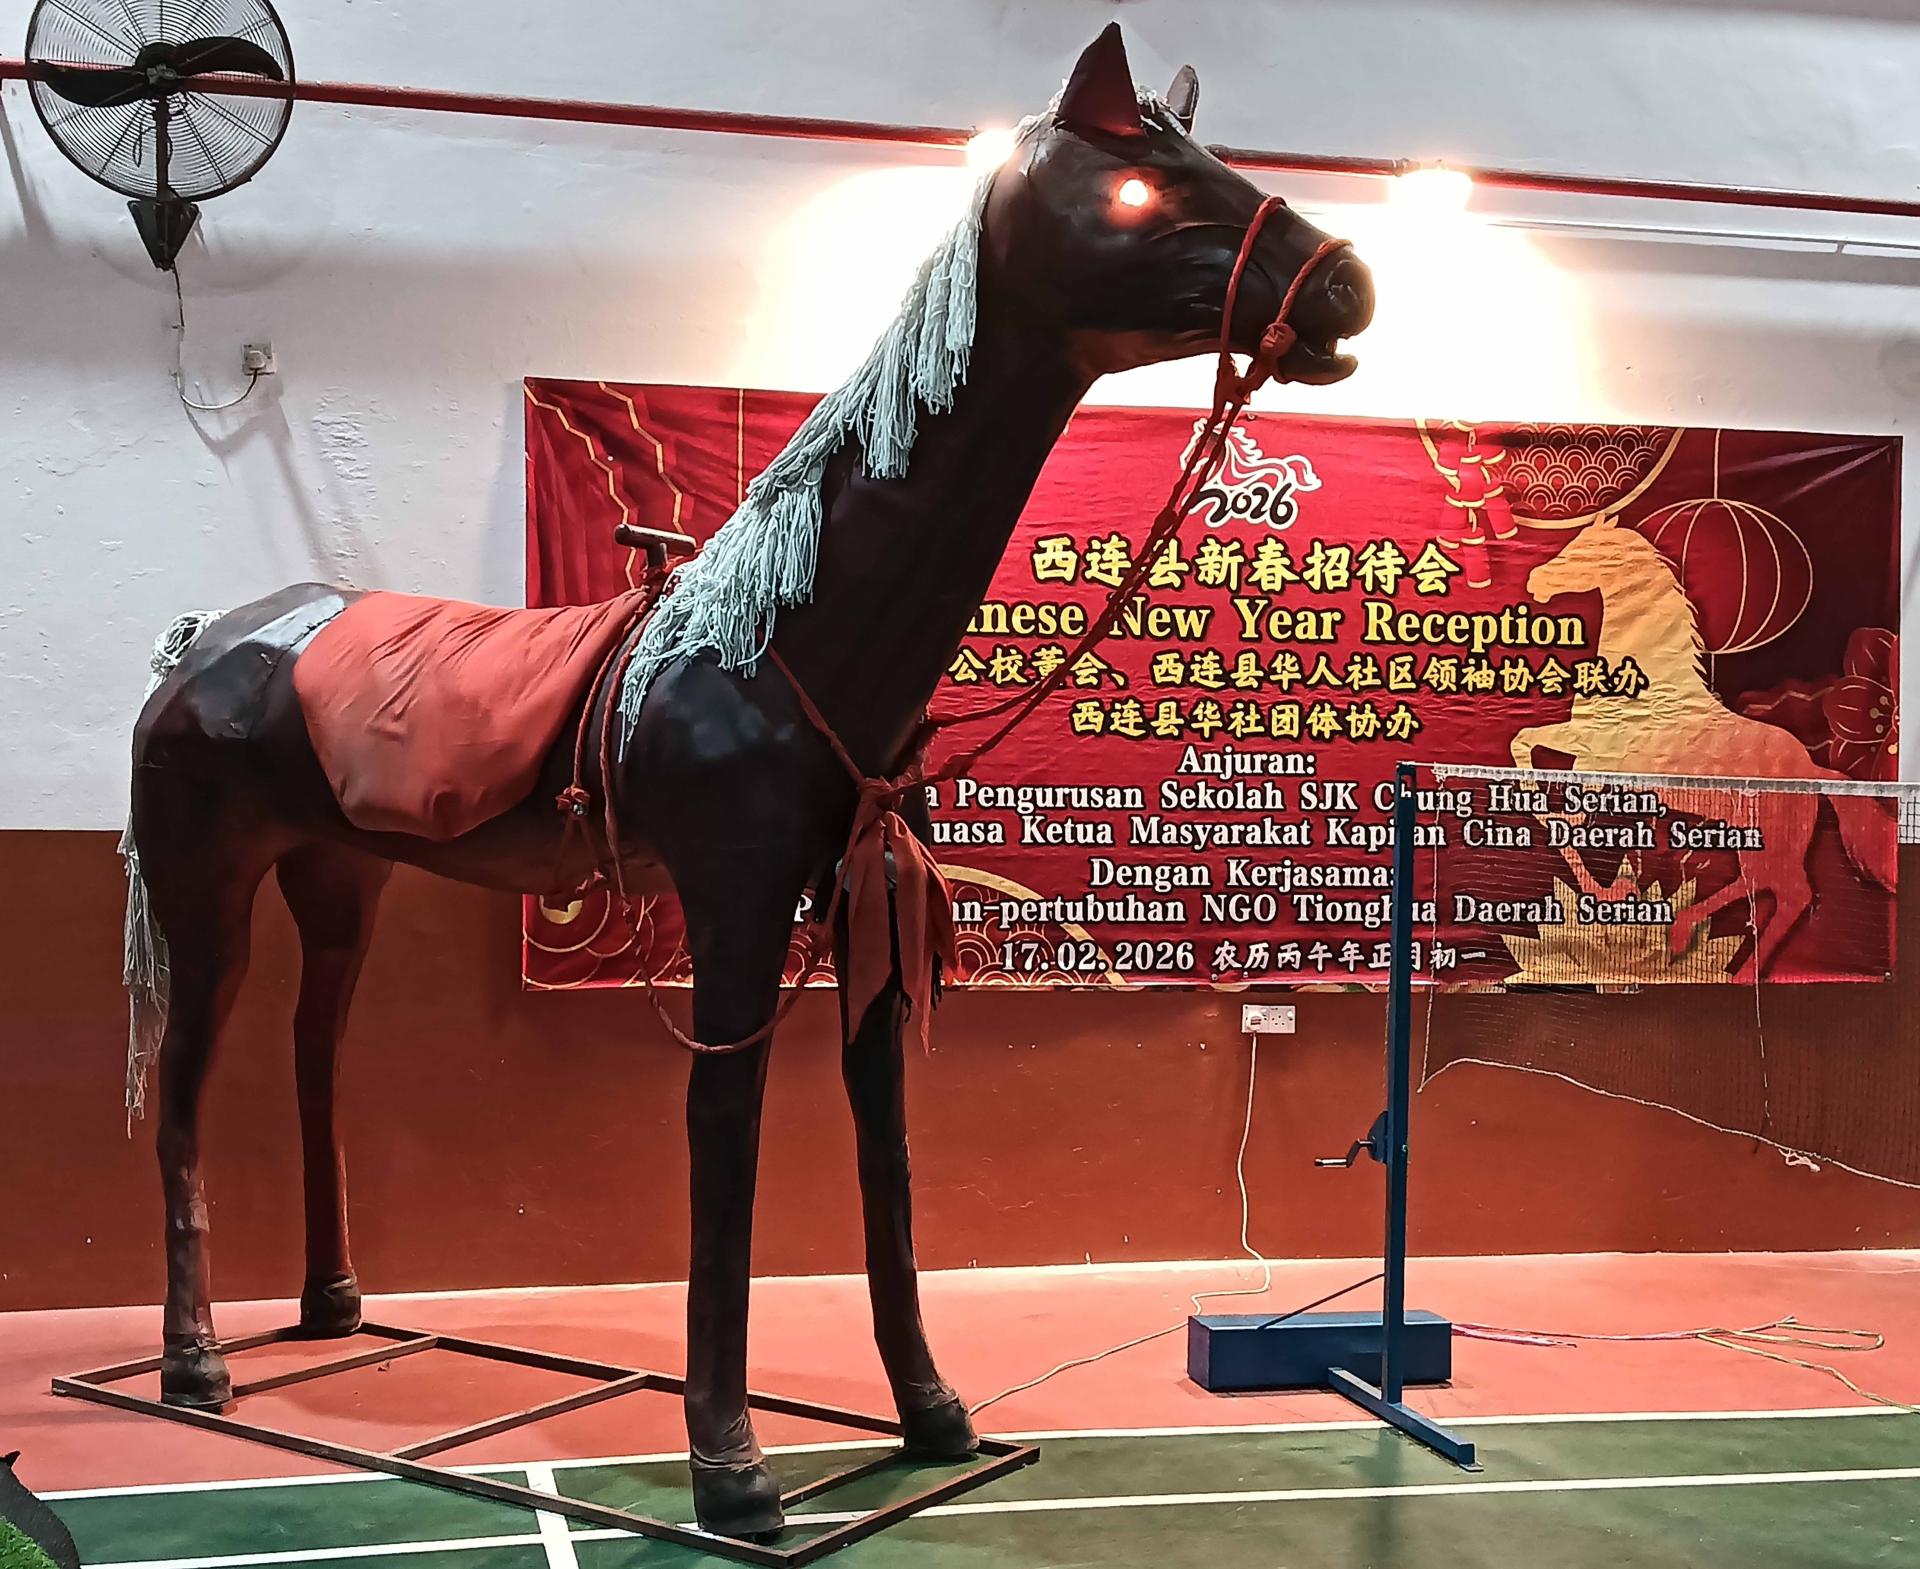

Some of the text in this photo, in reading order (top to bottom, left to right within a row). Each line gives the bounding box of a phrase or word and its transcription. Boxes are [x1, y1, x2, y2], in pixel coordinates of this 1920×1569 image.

[1189, 483, 1293, 525] 2026
[1034, 537, 1459, 594] 西连县新春招待会
[1109, 597, 1211, 639] New
[1234, 599, 1341, 641] Year
[1364, 603, 1584, 653] Reception
[1073, 704, 1419, 739] 西连县华社团体协办
[1178, 746, 1315, 779] Anjuran:
[956, 779, 1142, 814] Pengurusan
[1161, 781, 1284, 810] Sekolah
[1301, 783, 1357, 811] SJK
[1488, 785, 1548, 812] Hua
[1565, 787, 1667, 818] Serian,
[1022, 816, 1113, 844] Ketua
[1131, 817, 1310, 850] Masyarakat
[1327, 818, 1446, 852] Kapian
[1464, 821, 1531, 847] Cina
[1549, 821, 1655, 848] Daerah
[1670, 824, 1763, 848] Serian
[1091, 858, 1210, 892] Dengan
[1202, 896, 1277, 922] NGO
[1454, 895, 1562, 923] Daerah
[1578, 897, 1673, 924] Serian
[1003, 942, 1194, 970] 17.02.2026
